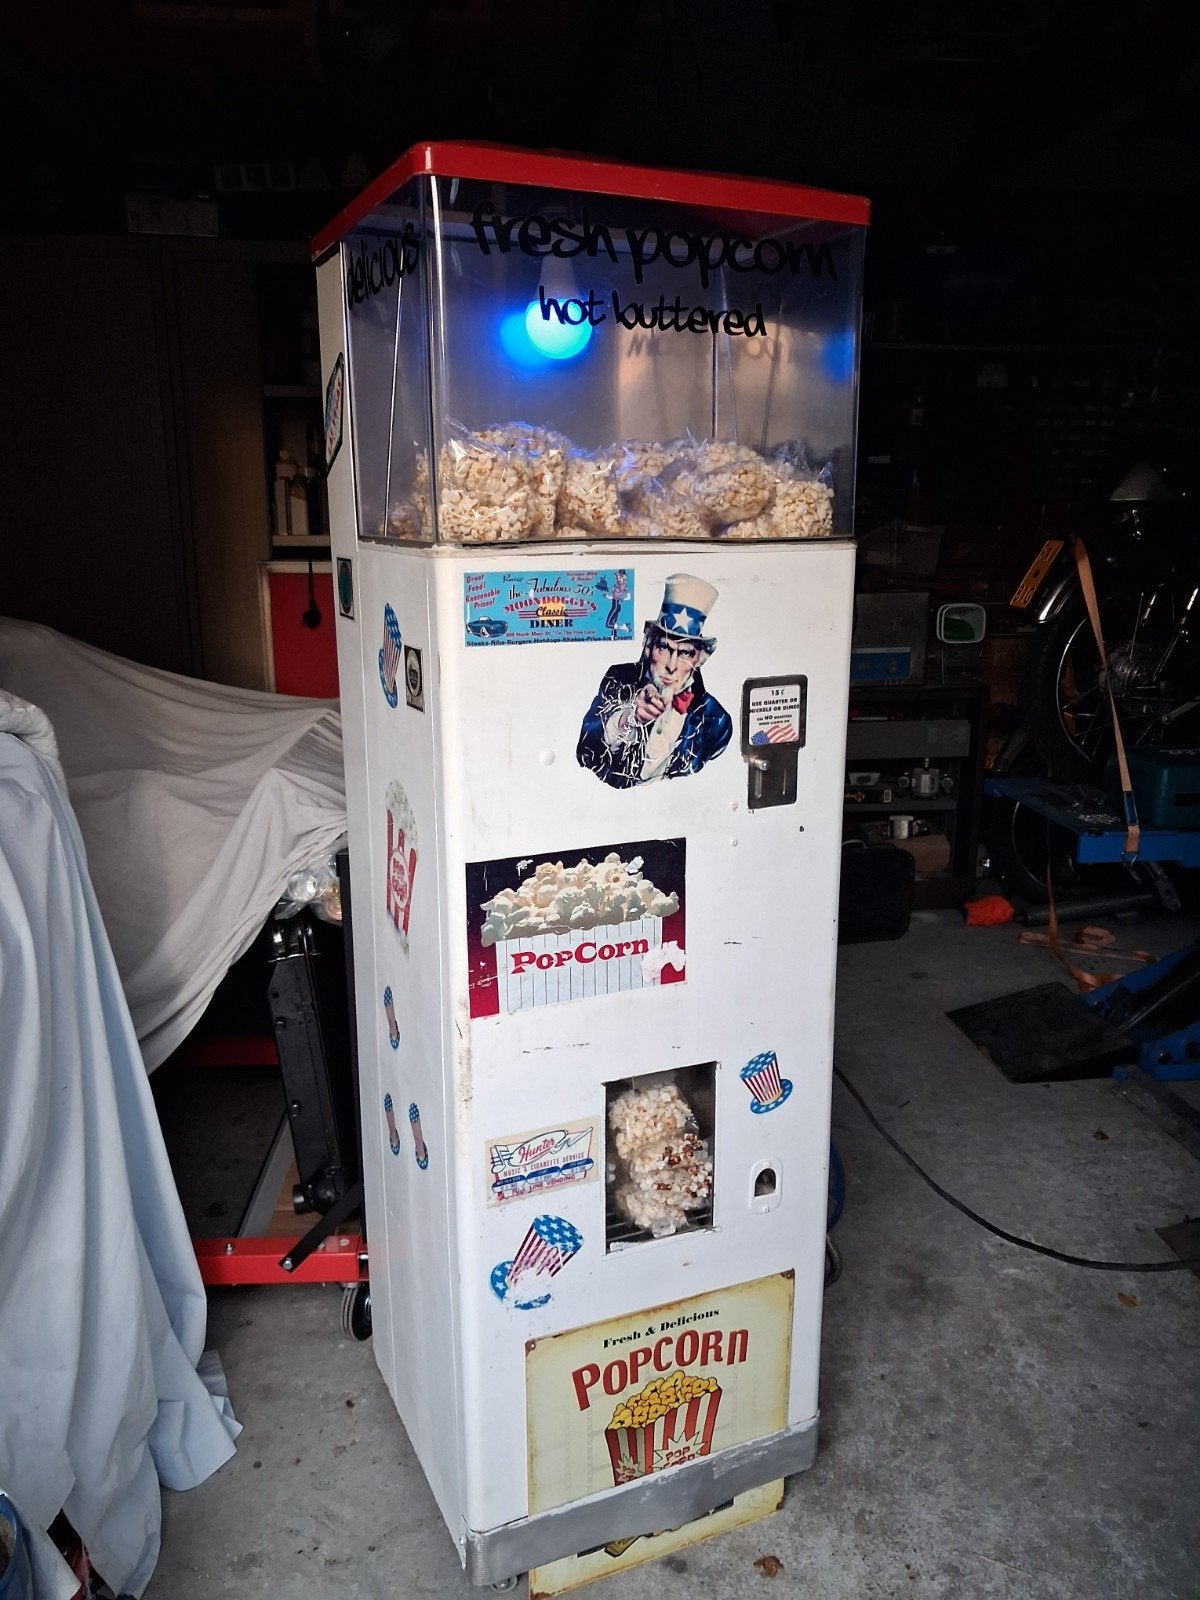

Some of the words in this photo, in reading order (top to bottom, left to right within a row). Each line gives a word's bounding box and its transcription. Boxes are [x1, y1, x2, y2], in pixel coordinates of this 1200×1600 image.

[469, 201, 619, 263] fresh
[625, 225, 838, 289] popcorn
[347, 222, 420, 311] delicious
[538, 285, 607, 327] hot
[612, 290, 767, 337] buttered
[465, 588, 500, 603] Reasonable
[530, 619, 574, 629] DINER
[536, 606, 569, 617] Classic
[749, 706, 772, 714] NICKELS
[511, 938, 649, 975] PopCorn
[518, 1138, 556, 1164] Hunter
[503, 1168, 521, 1177] MUSIC
[530, 1157, 560, 1171] CIGARETTE
[562, 1152, 585, 1162] SERVICE
[529, 1182, 544, 1191] LINE
[545, 1175, 576, 1187] VENDING
[603, 1330, 641, 1348] Fresh
[645, 1326, 656, 1336] &
[660, 1309, 720, 1332] Delicious
[665, 1446, 690, 1461] POP
